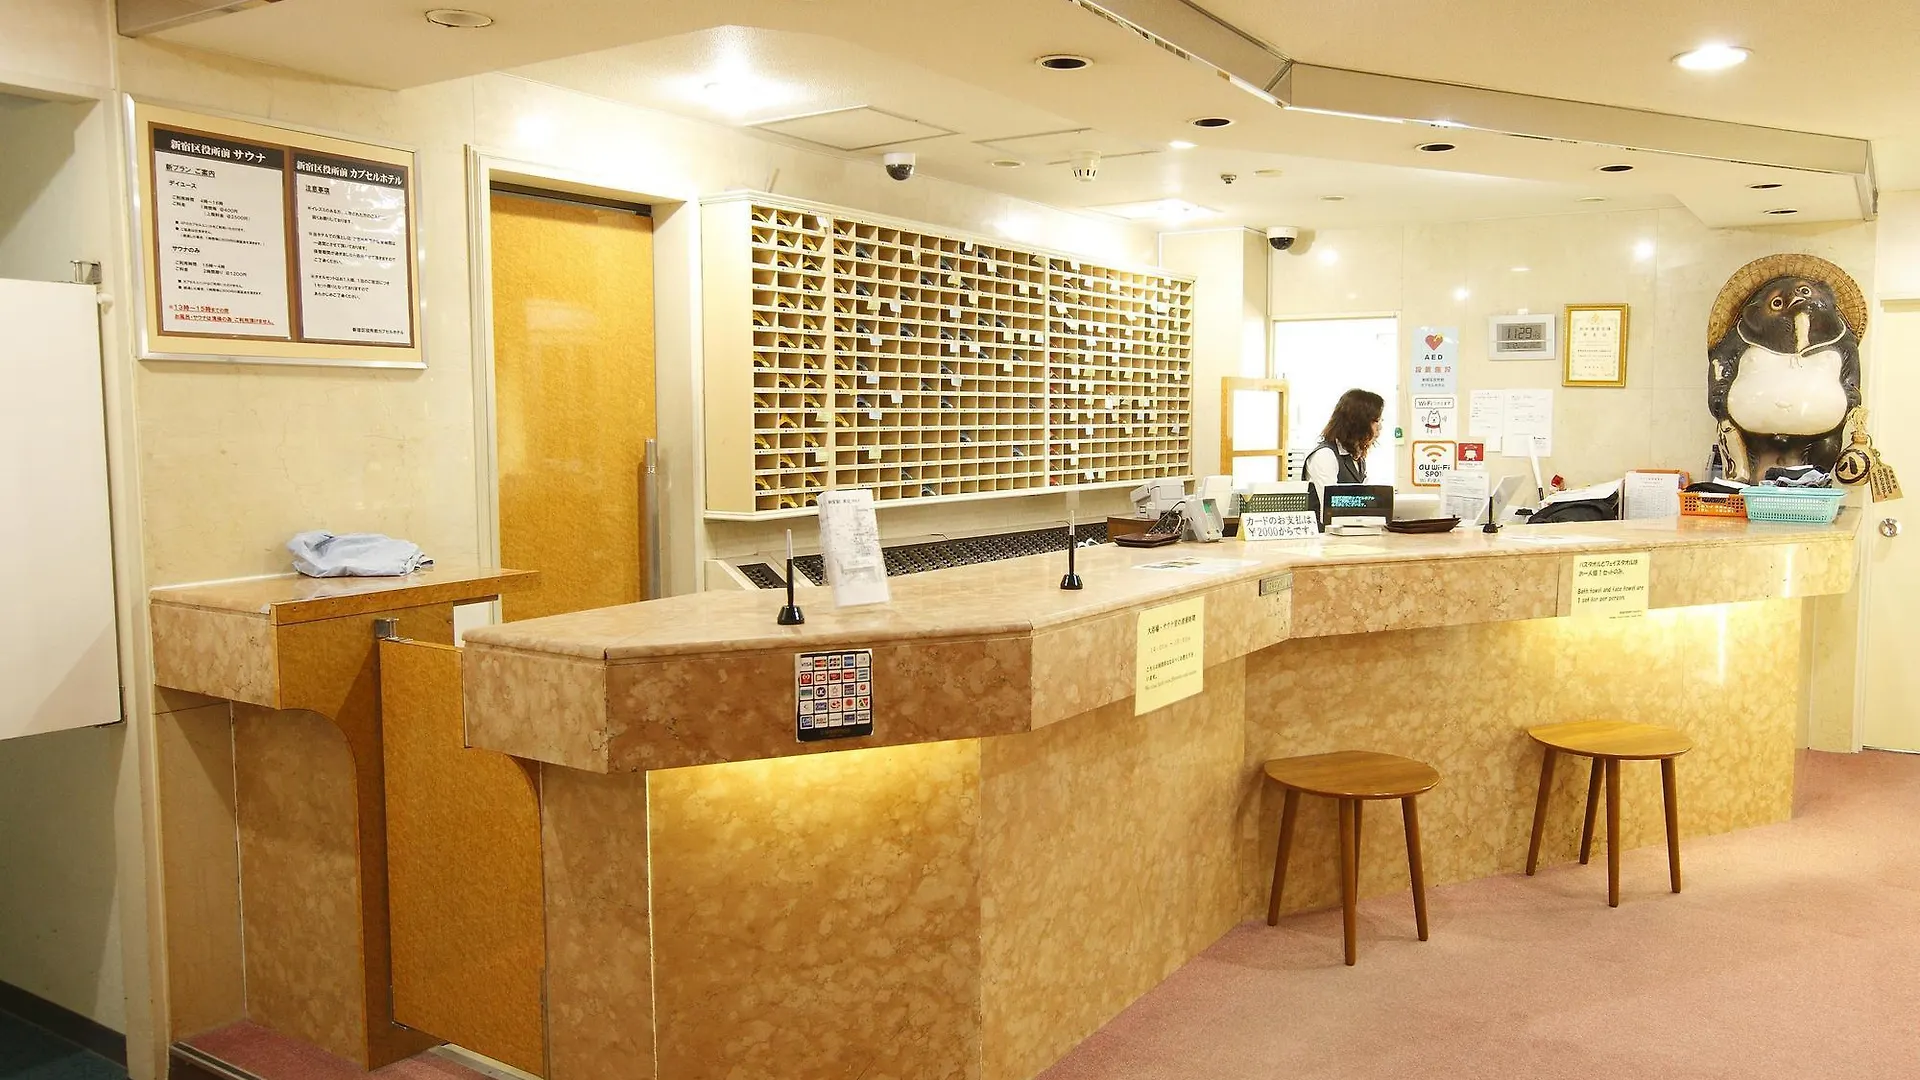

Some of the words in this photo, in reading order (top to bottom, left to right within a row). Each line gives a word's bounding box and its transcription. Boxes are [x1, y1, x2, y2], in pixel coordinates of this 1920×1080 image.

[170, 138, 230, 158] 新宿区役所前
[232, 148, 265, 163] サウナ
[165, 163, 191, 174] 新プラン
[194, 167, 215, 177] ご案内
[296, 160, 347, 177] 新宿区役所前
[349, 168, 402, 186] カプセルホテル
[168, 179, 196, 189] デイユース
[172, 245, 199, 253] サウナのみ
[1246, 515, 1316, 526] カードのお支払は、
